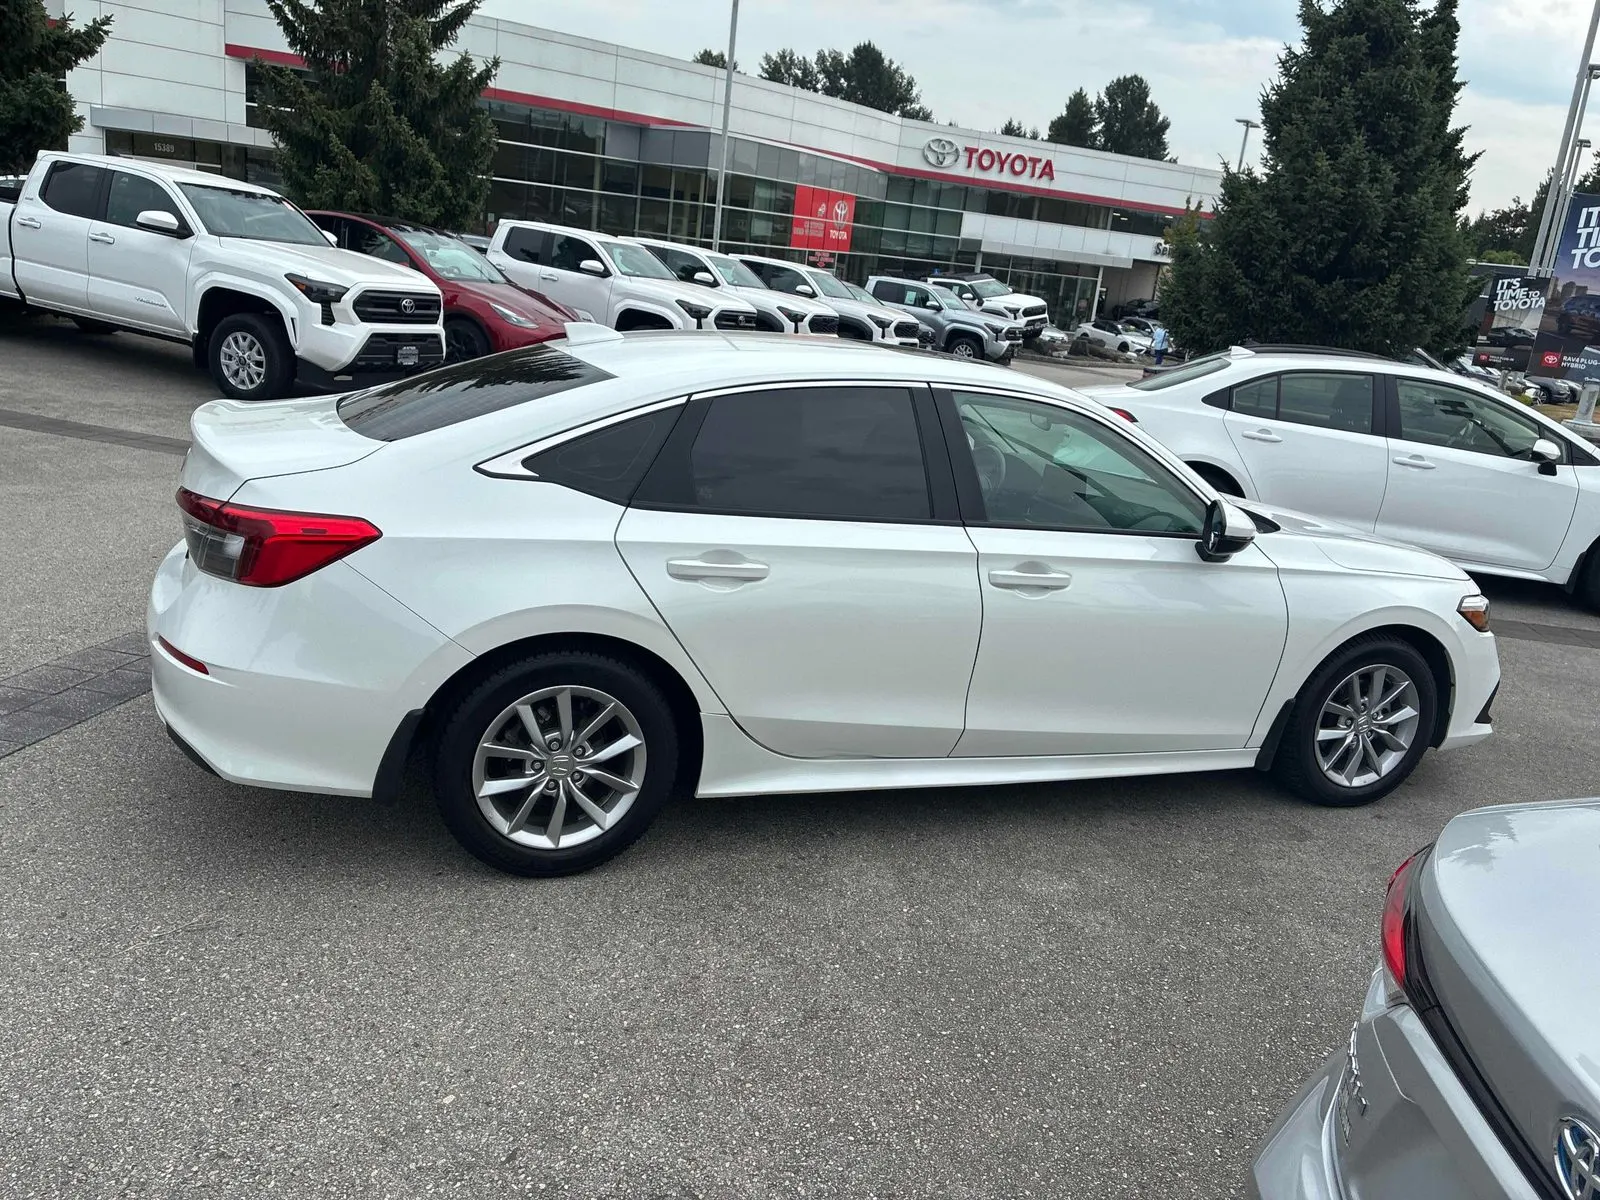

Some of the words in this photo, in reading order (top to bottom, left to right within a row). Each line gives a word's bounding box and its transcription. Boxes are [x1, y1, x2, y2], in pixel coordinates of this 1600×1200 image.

[154, 142, 175, 153] 15389
[964, 146, 1055, 181] TOYOTA
[830, 229, 848, 240] TOYOTA
[1496, 277, 1521, 290] IT'S
[1496, 287, 1529, 301] TIME
[1528, 290, 1540, 298] TO
[1493, 296, 1546, 311] TOYOTA
[1562, 355, 1580, 363] RAV4
[1560, 361, 1586, 370] HYBRID
